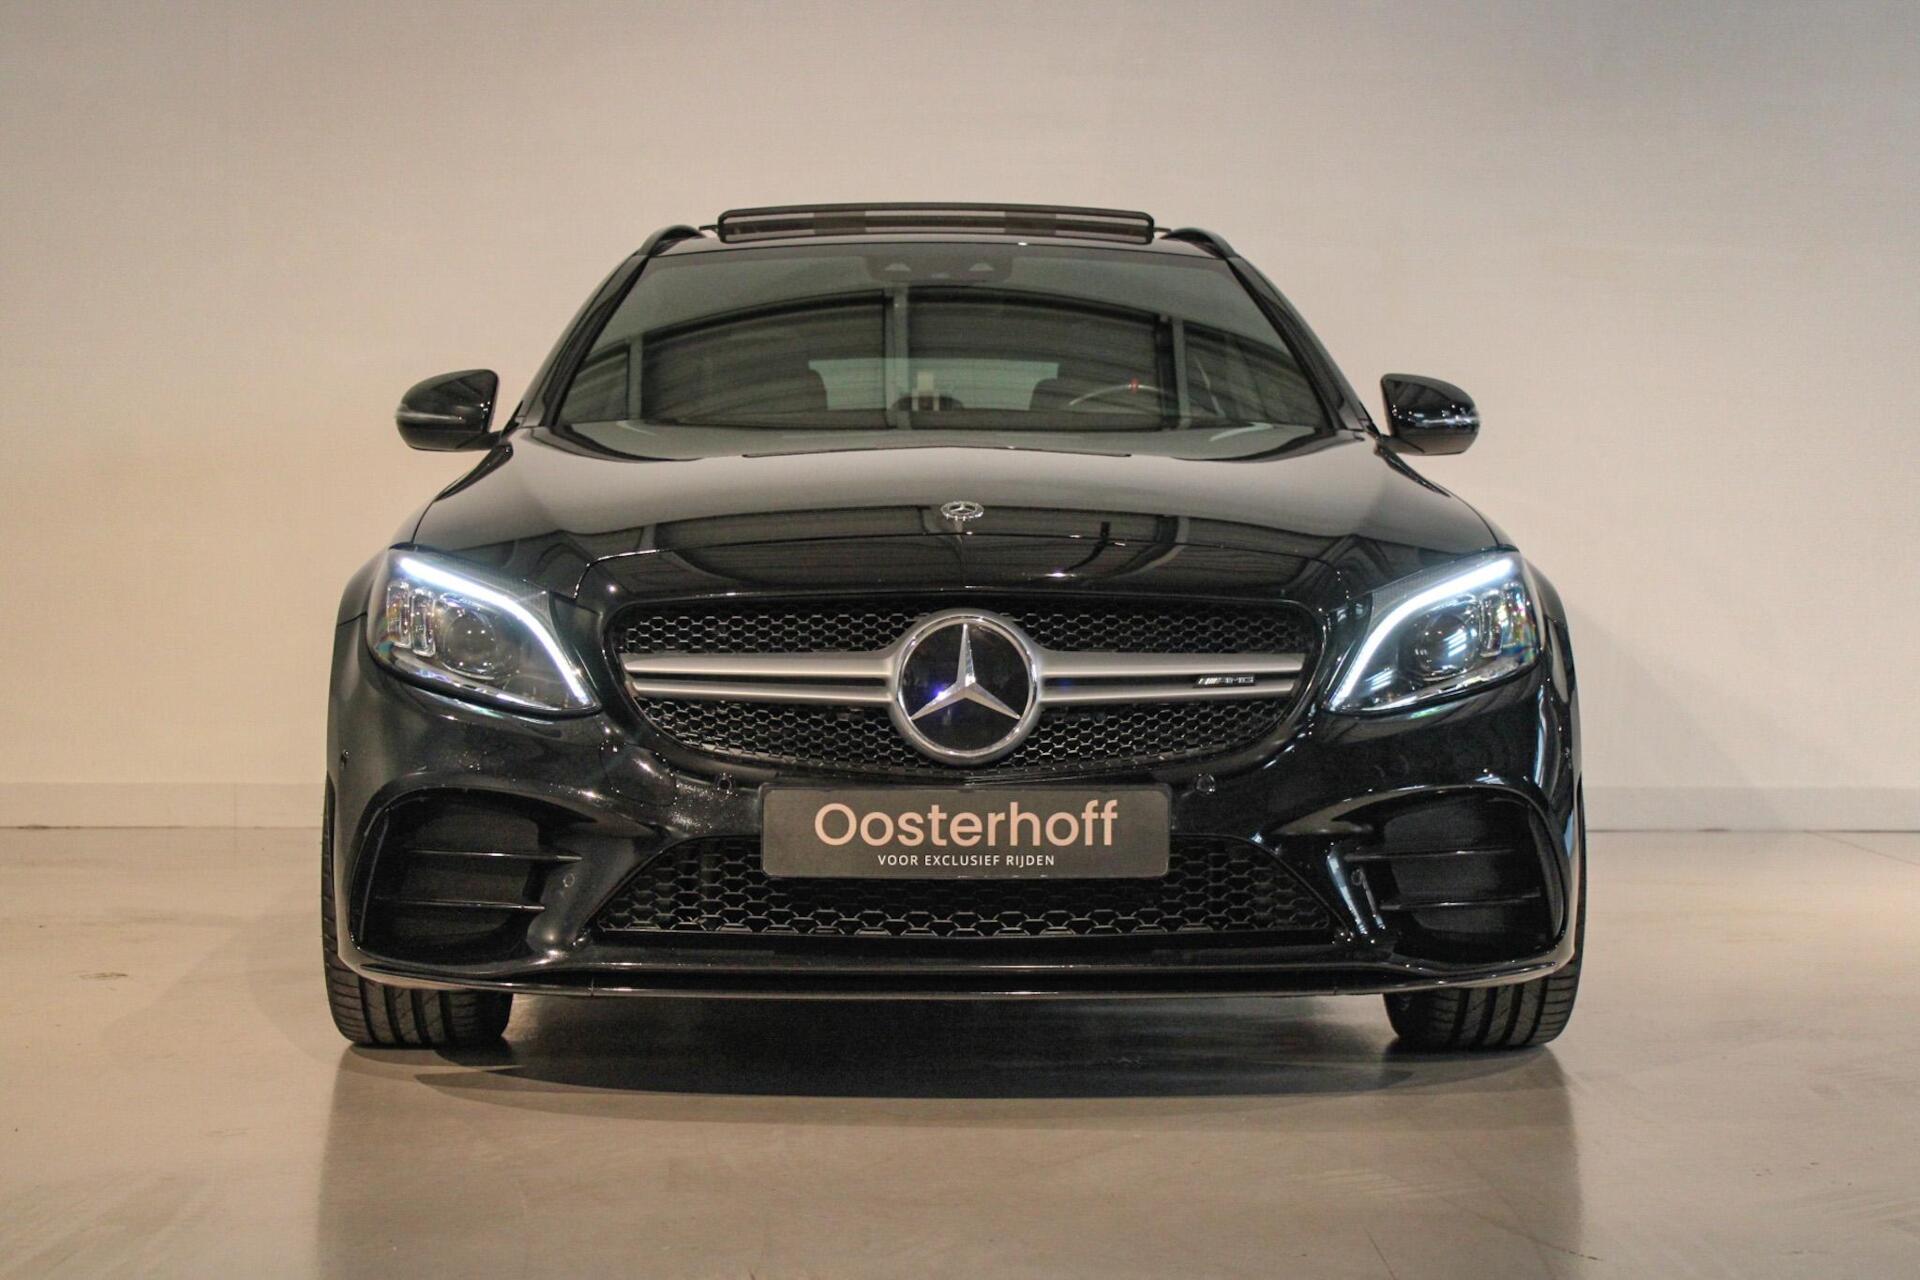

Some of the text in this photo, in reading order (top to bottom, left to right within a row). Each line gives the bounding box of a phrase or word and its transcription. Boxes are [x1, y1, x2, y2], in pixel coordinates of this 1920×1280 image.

[814, 799, 1118, 847] Oosterhoff
[877, 854, 1055, 868] VOOR EXCLUSIEF RIJDEN
